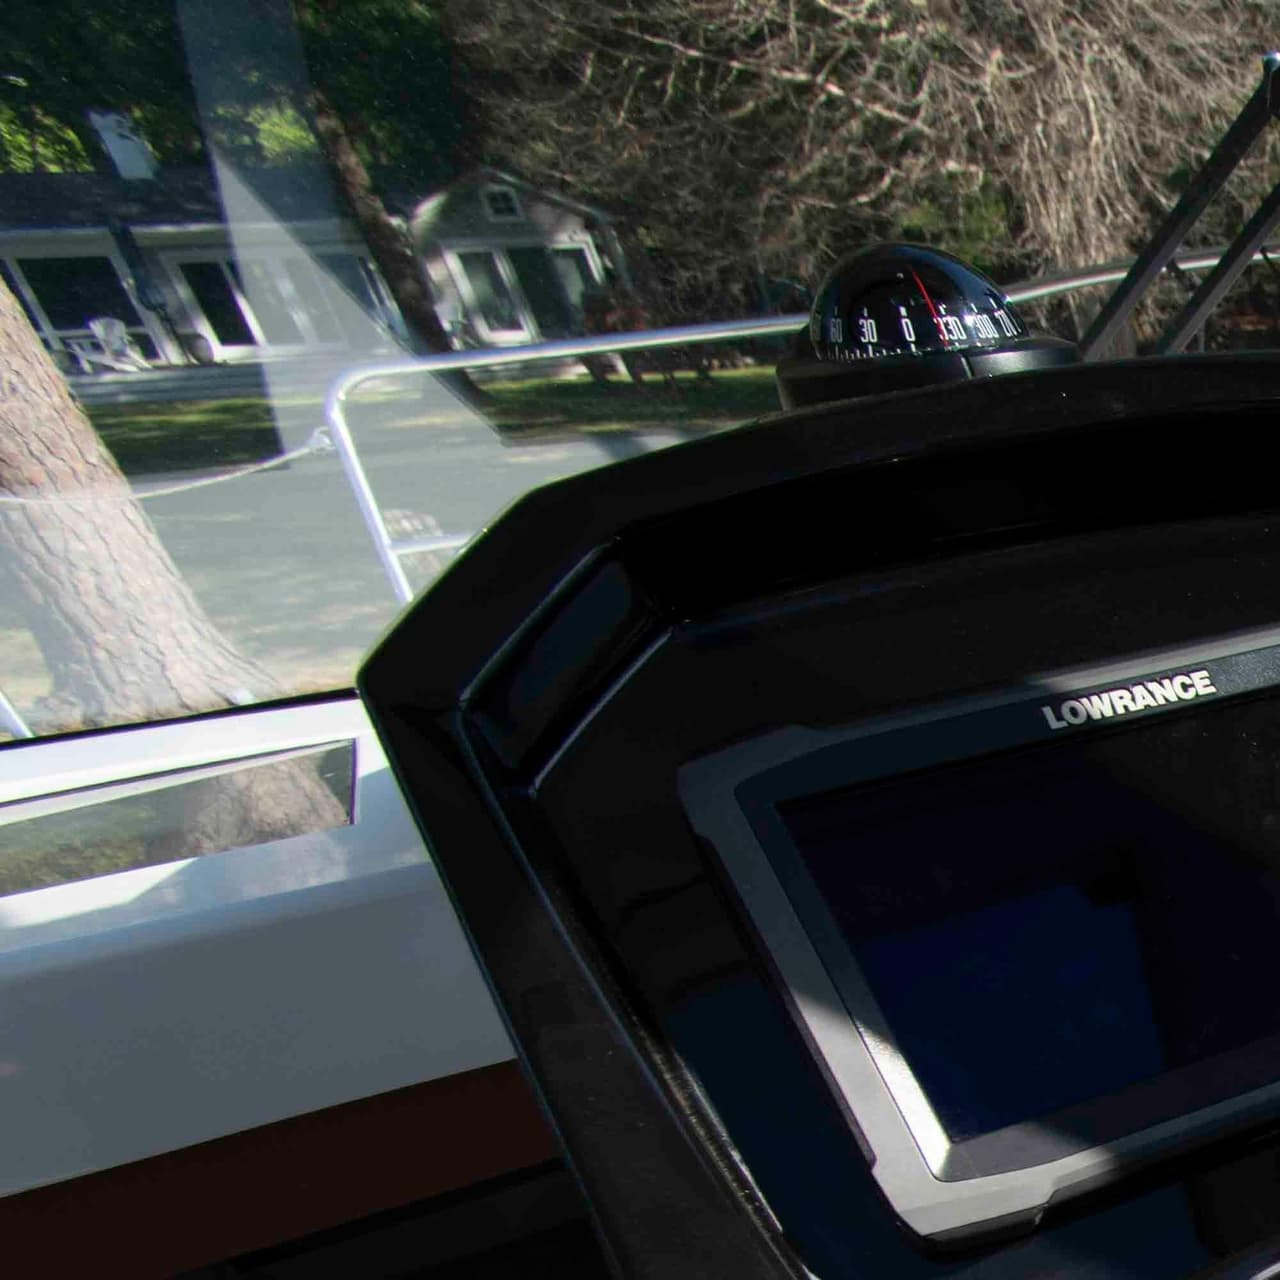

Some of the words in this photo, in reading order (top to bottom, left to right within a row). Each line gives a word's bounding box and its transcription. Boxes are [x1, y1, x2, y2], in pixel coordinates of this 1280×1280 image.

[858, 317, 878, 343] 30
[901, 317, 916, 342] 0
[1041, 669, 1217, 730] LOWRANCE
